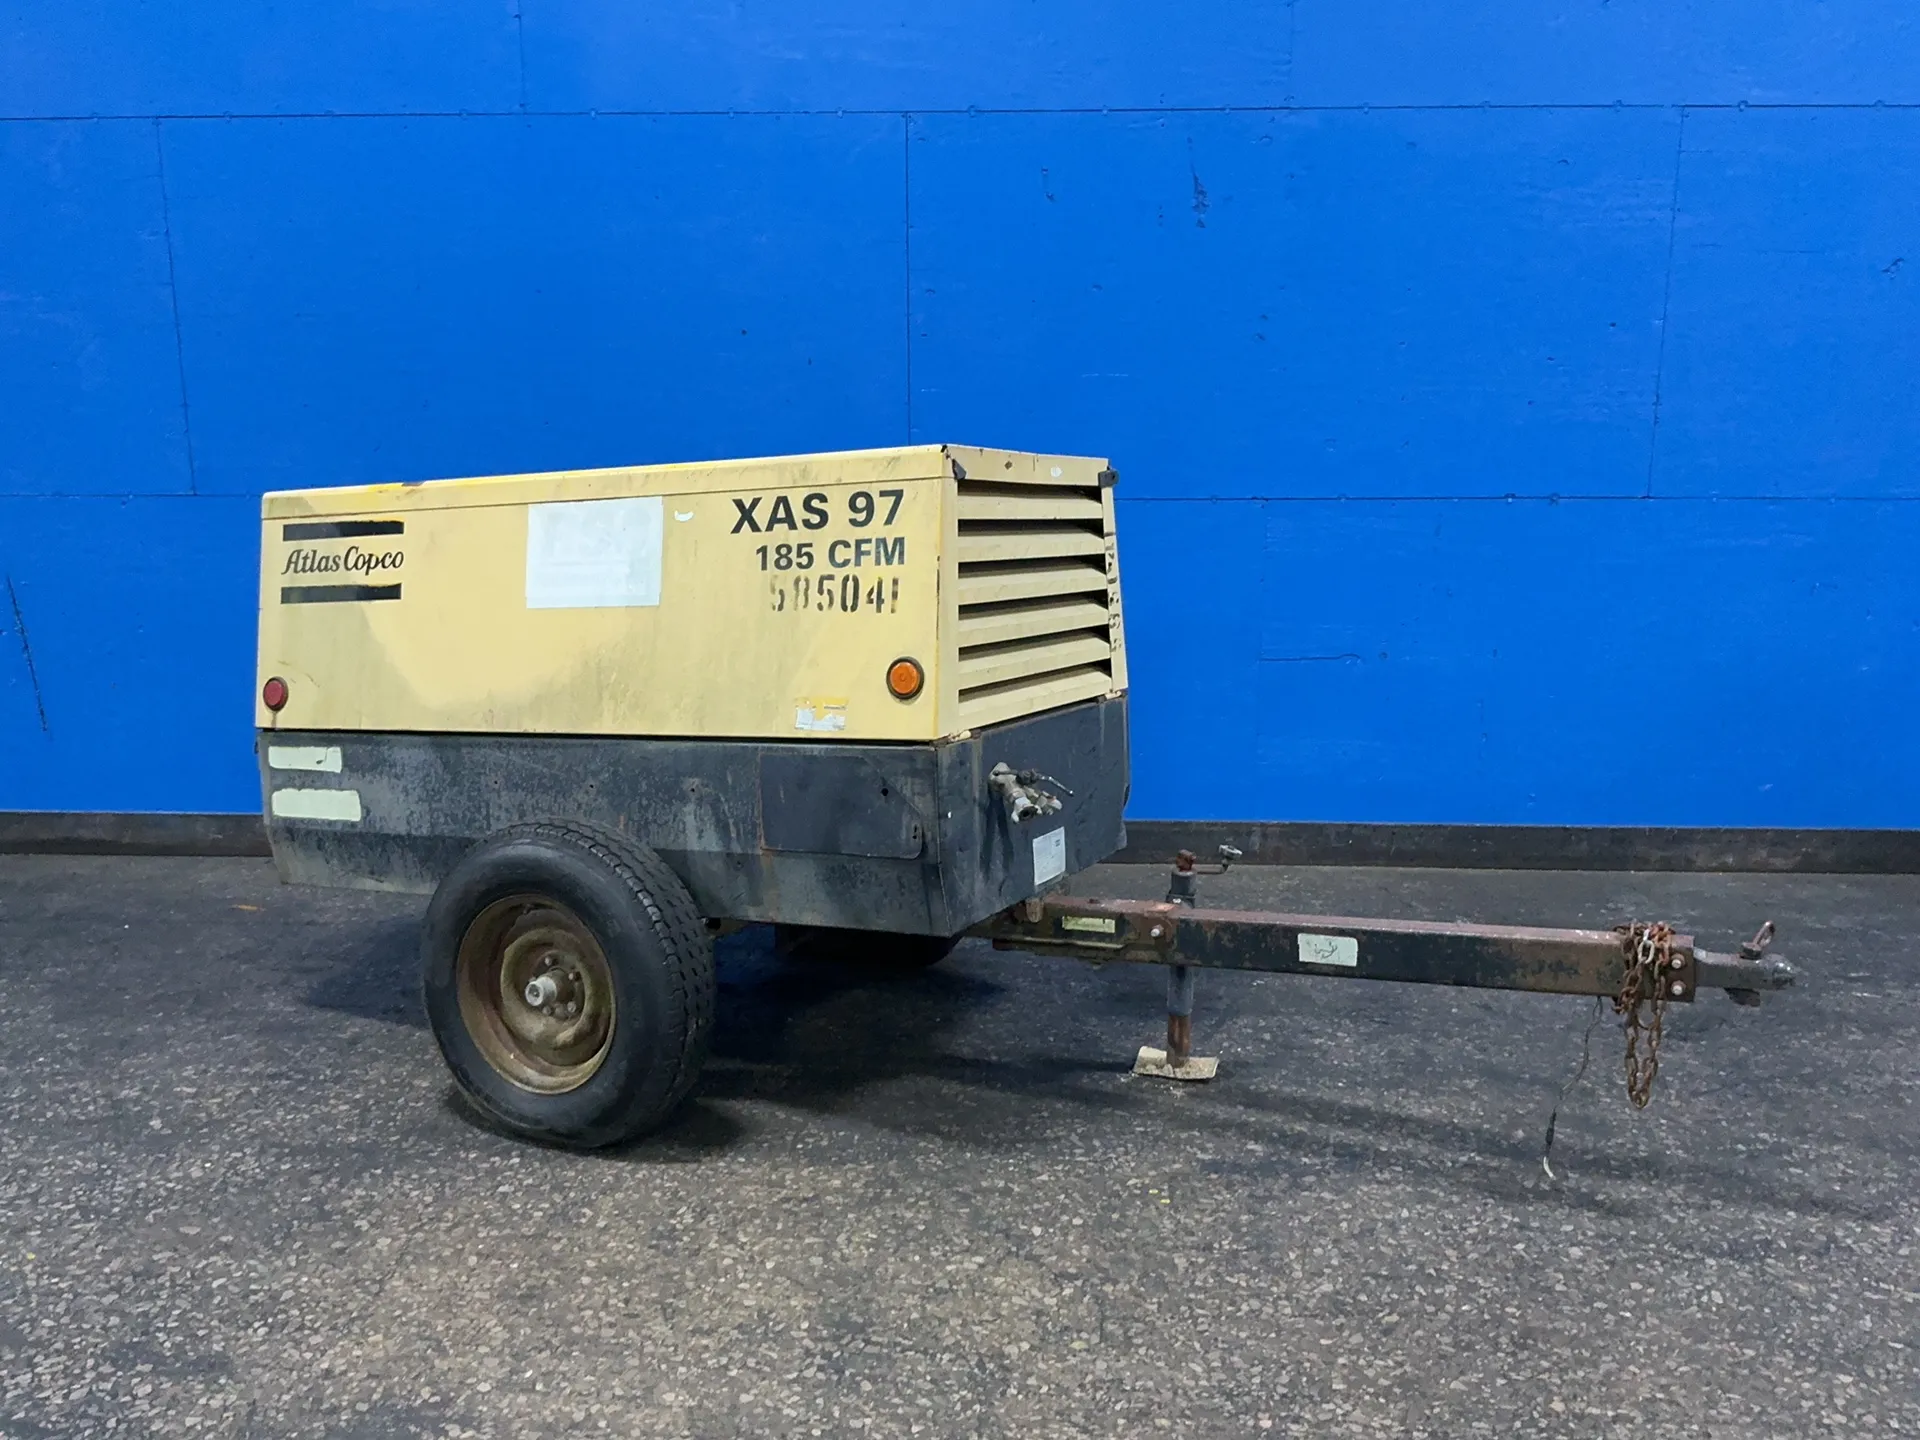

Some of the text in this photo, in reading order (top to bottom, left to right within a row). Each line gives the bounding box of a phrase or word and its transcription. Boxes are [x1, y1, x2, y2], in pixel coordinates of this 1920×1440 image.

[730, 489, 904, 534] XAS 97
[281, 545, 404, 576] Atlas Copco
[756, 536, 905, 571] 185 CFM
